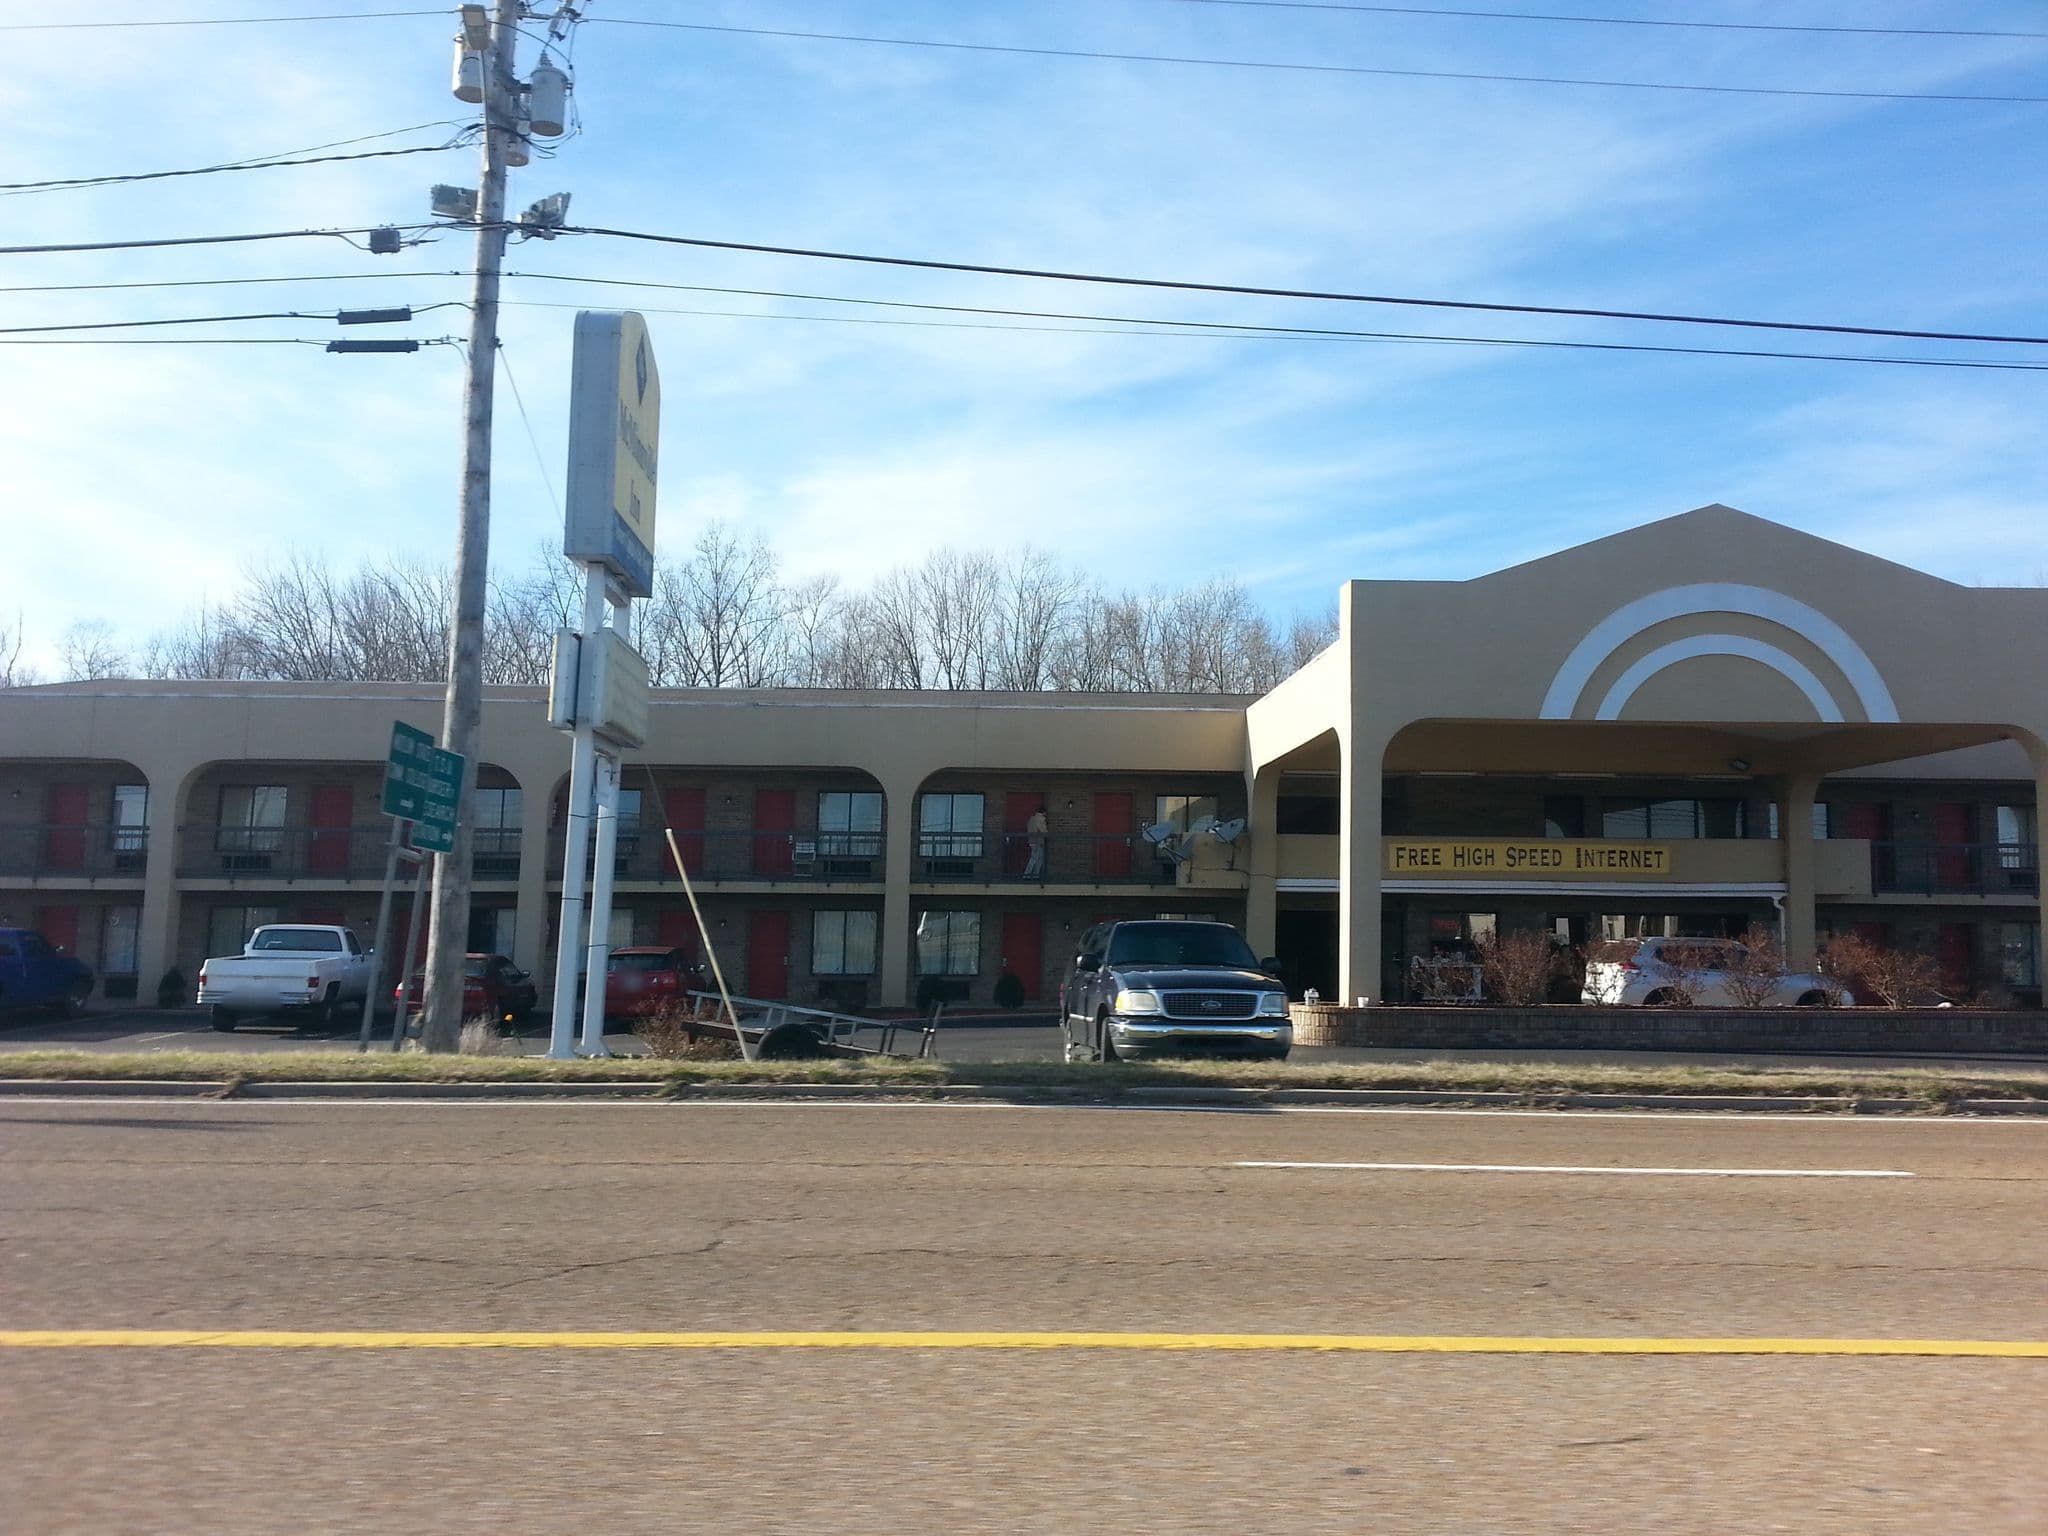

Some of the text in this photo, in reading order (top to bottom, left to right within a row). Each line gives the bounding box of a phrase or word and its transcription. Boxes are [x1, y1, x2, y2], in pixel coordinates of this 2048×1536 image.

[1396, 846, 1664, 869] FREE HIGH SPEED INTERNET
